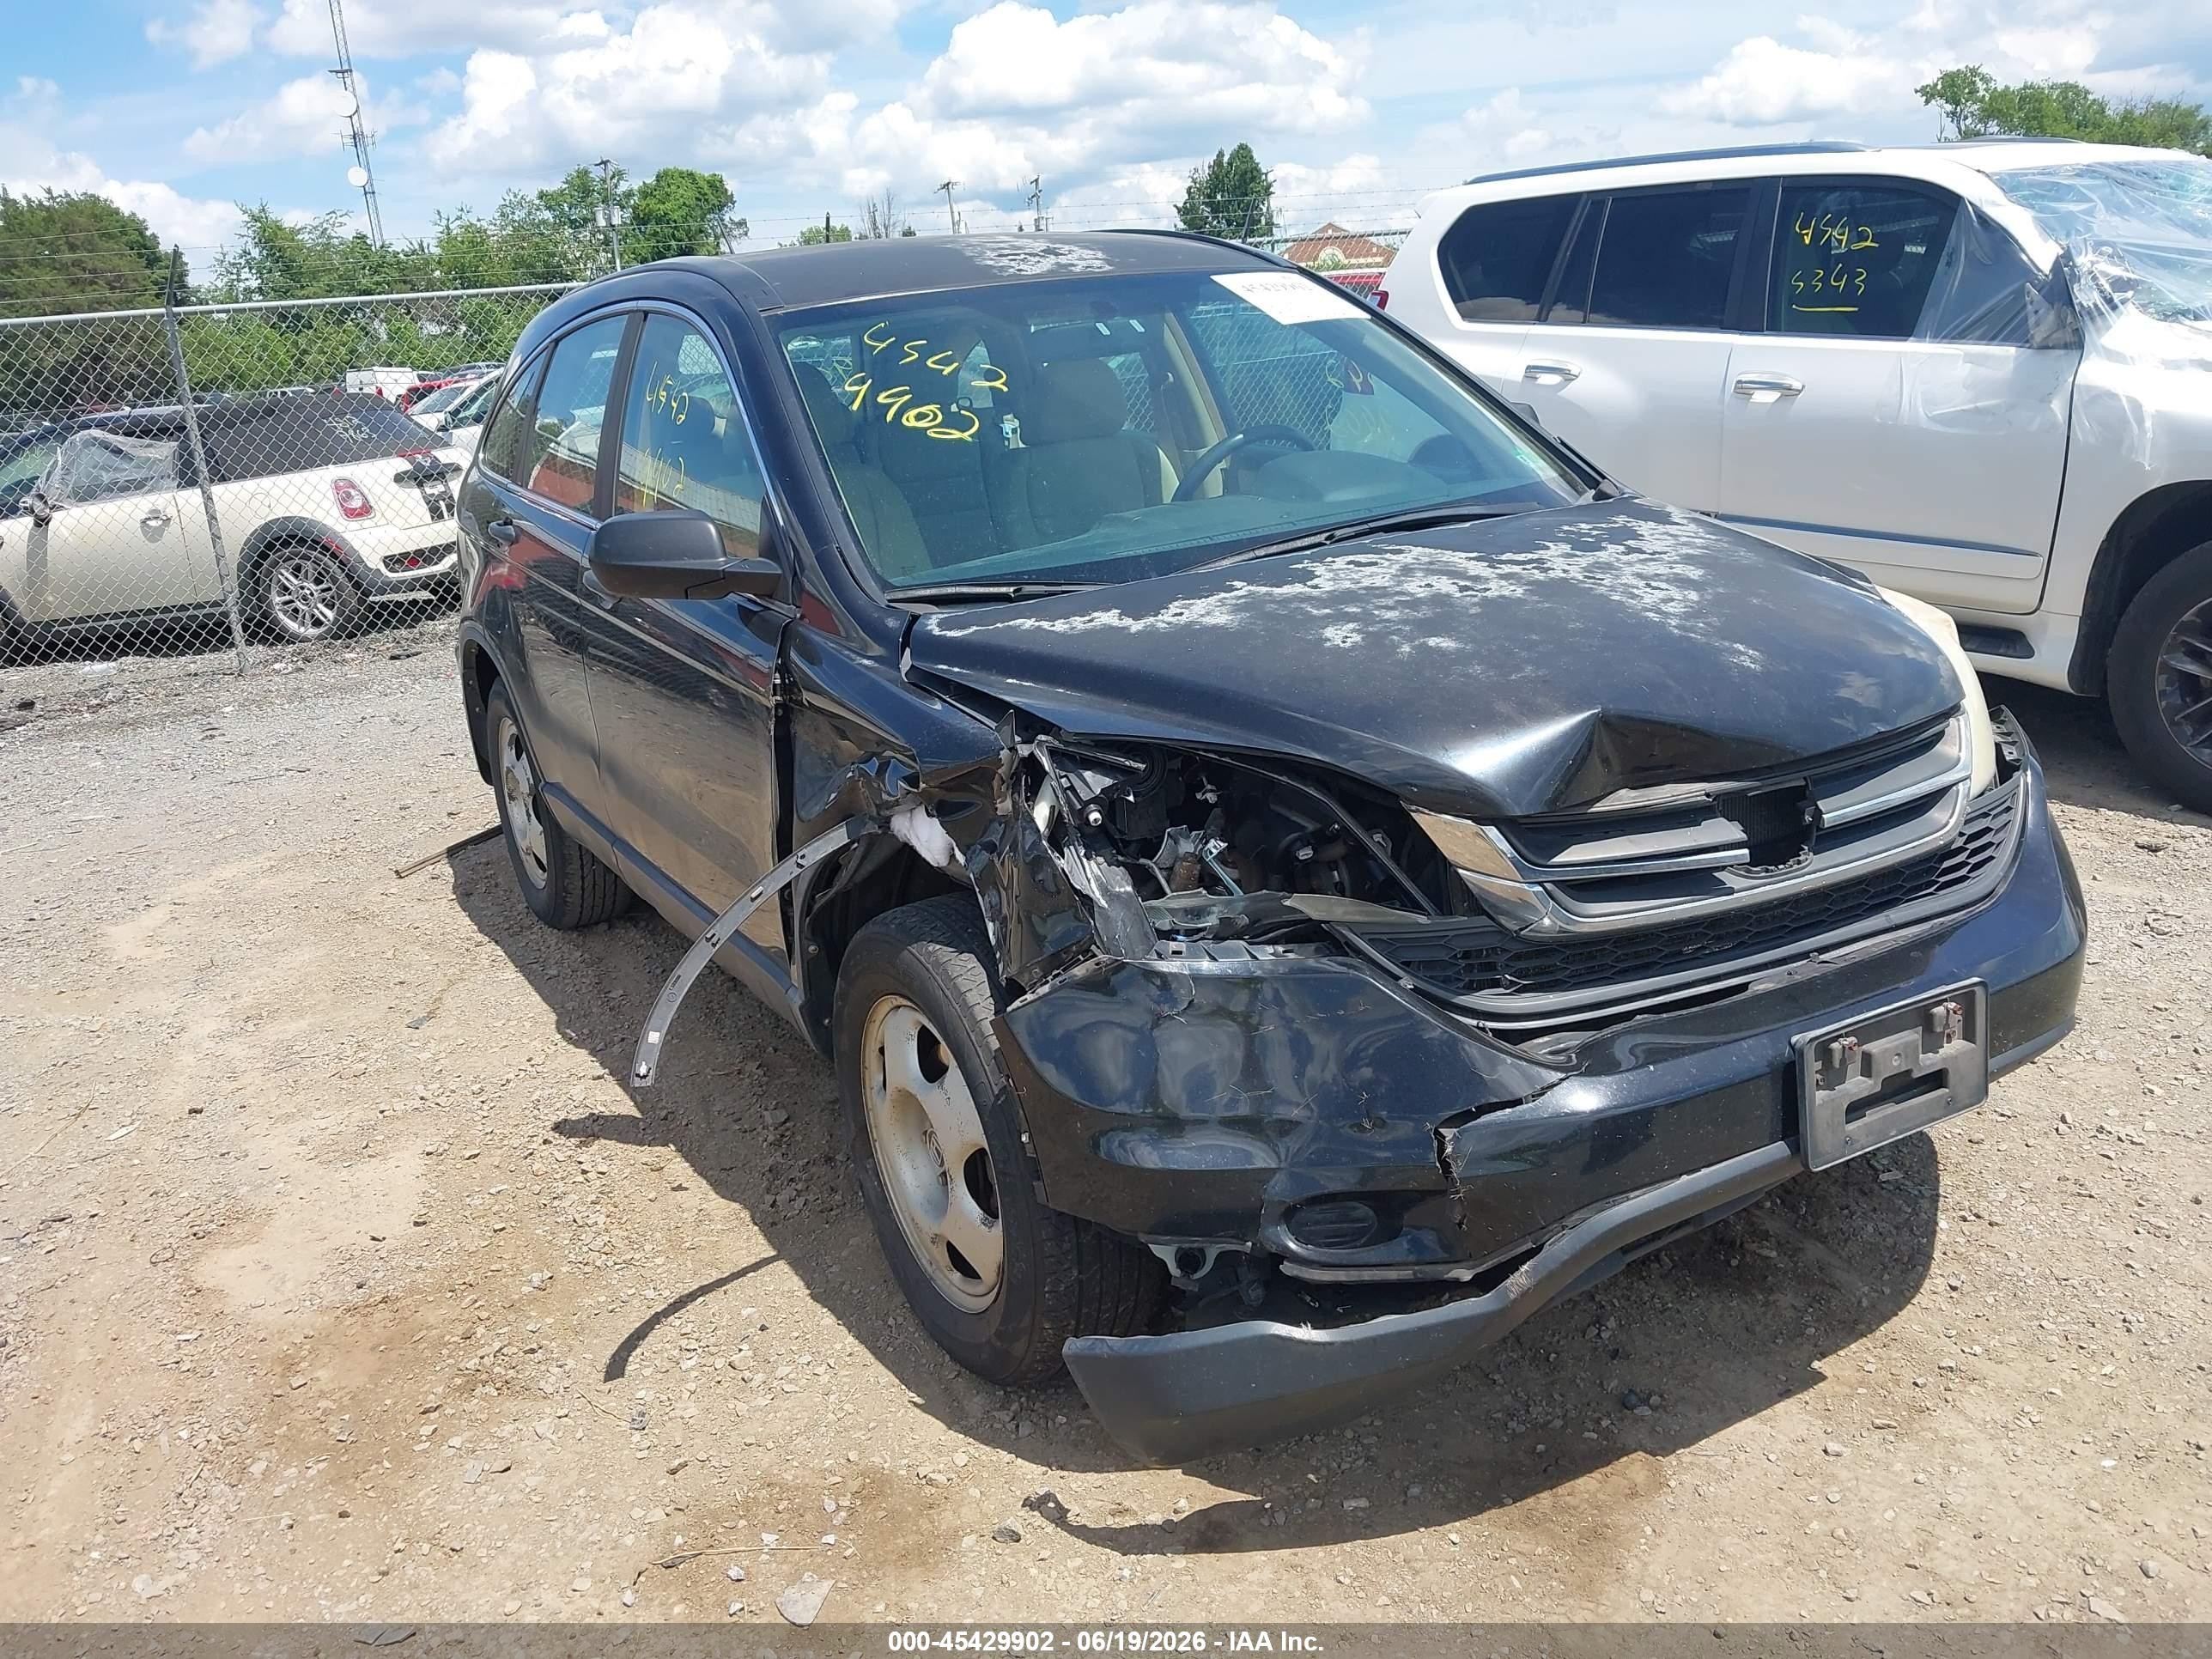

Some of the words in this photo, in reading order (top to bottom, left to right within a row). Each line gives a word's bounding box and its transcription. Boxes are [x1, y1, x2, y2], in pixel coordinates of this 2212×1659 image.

[1795, 211, 1880, 250] 4542
[1791, 263, 1867, 296] 5343
[862, 320, 1009, 392] 4542
[844, 373, 980, 441] 9902
